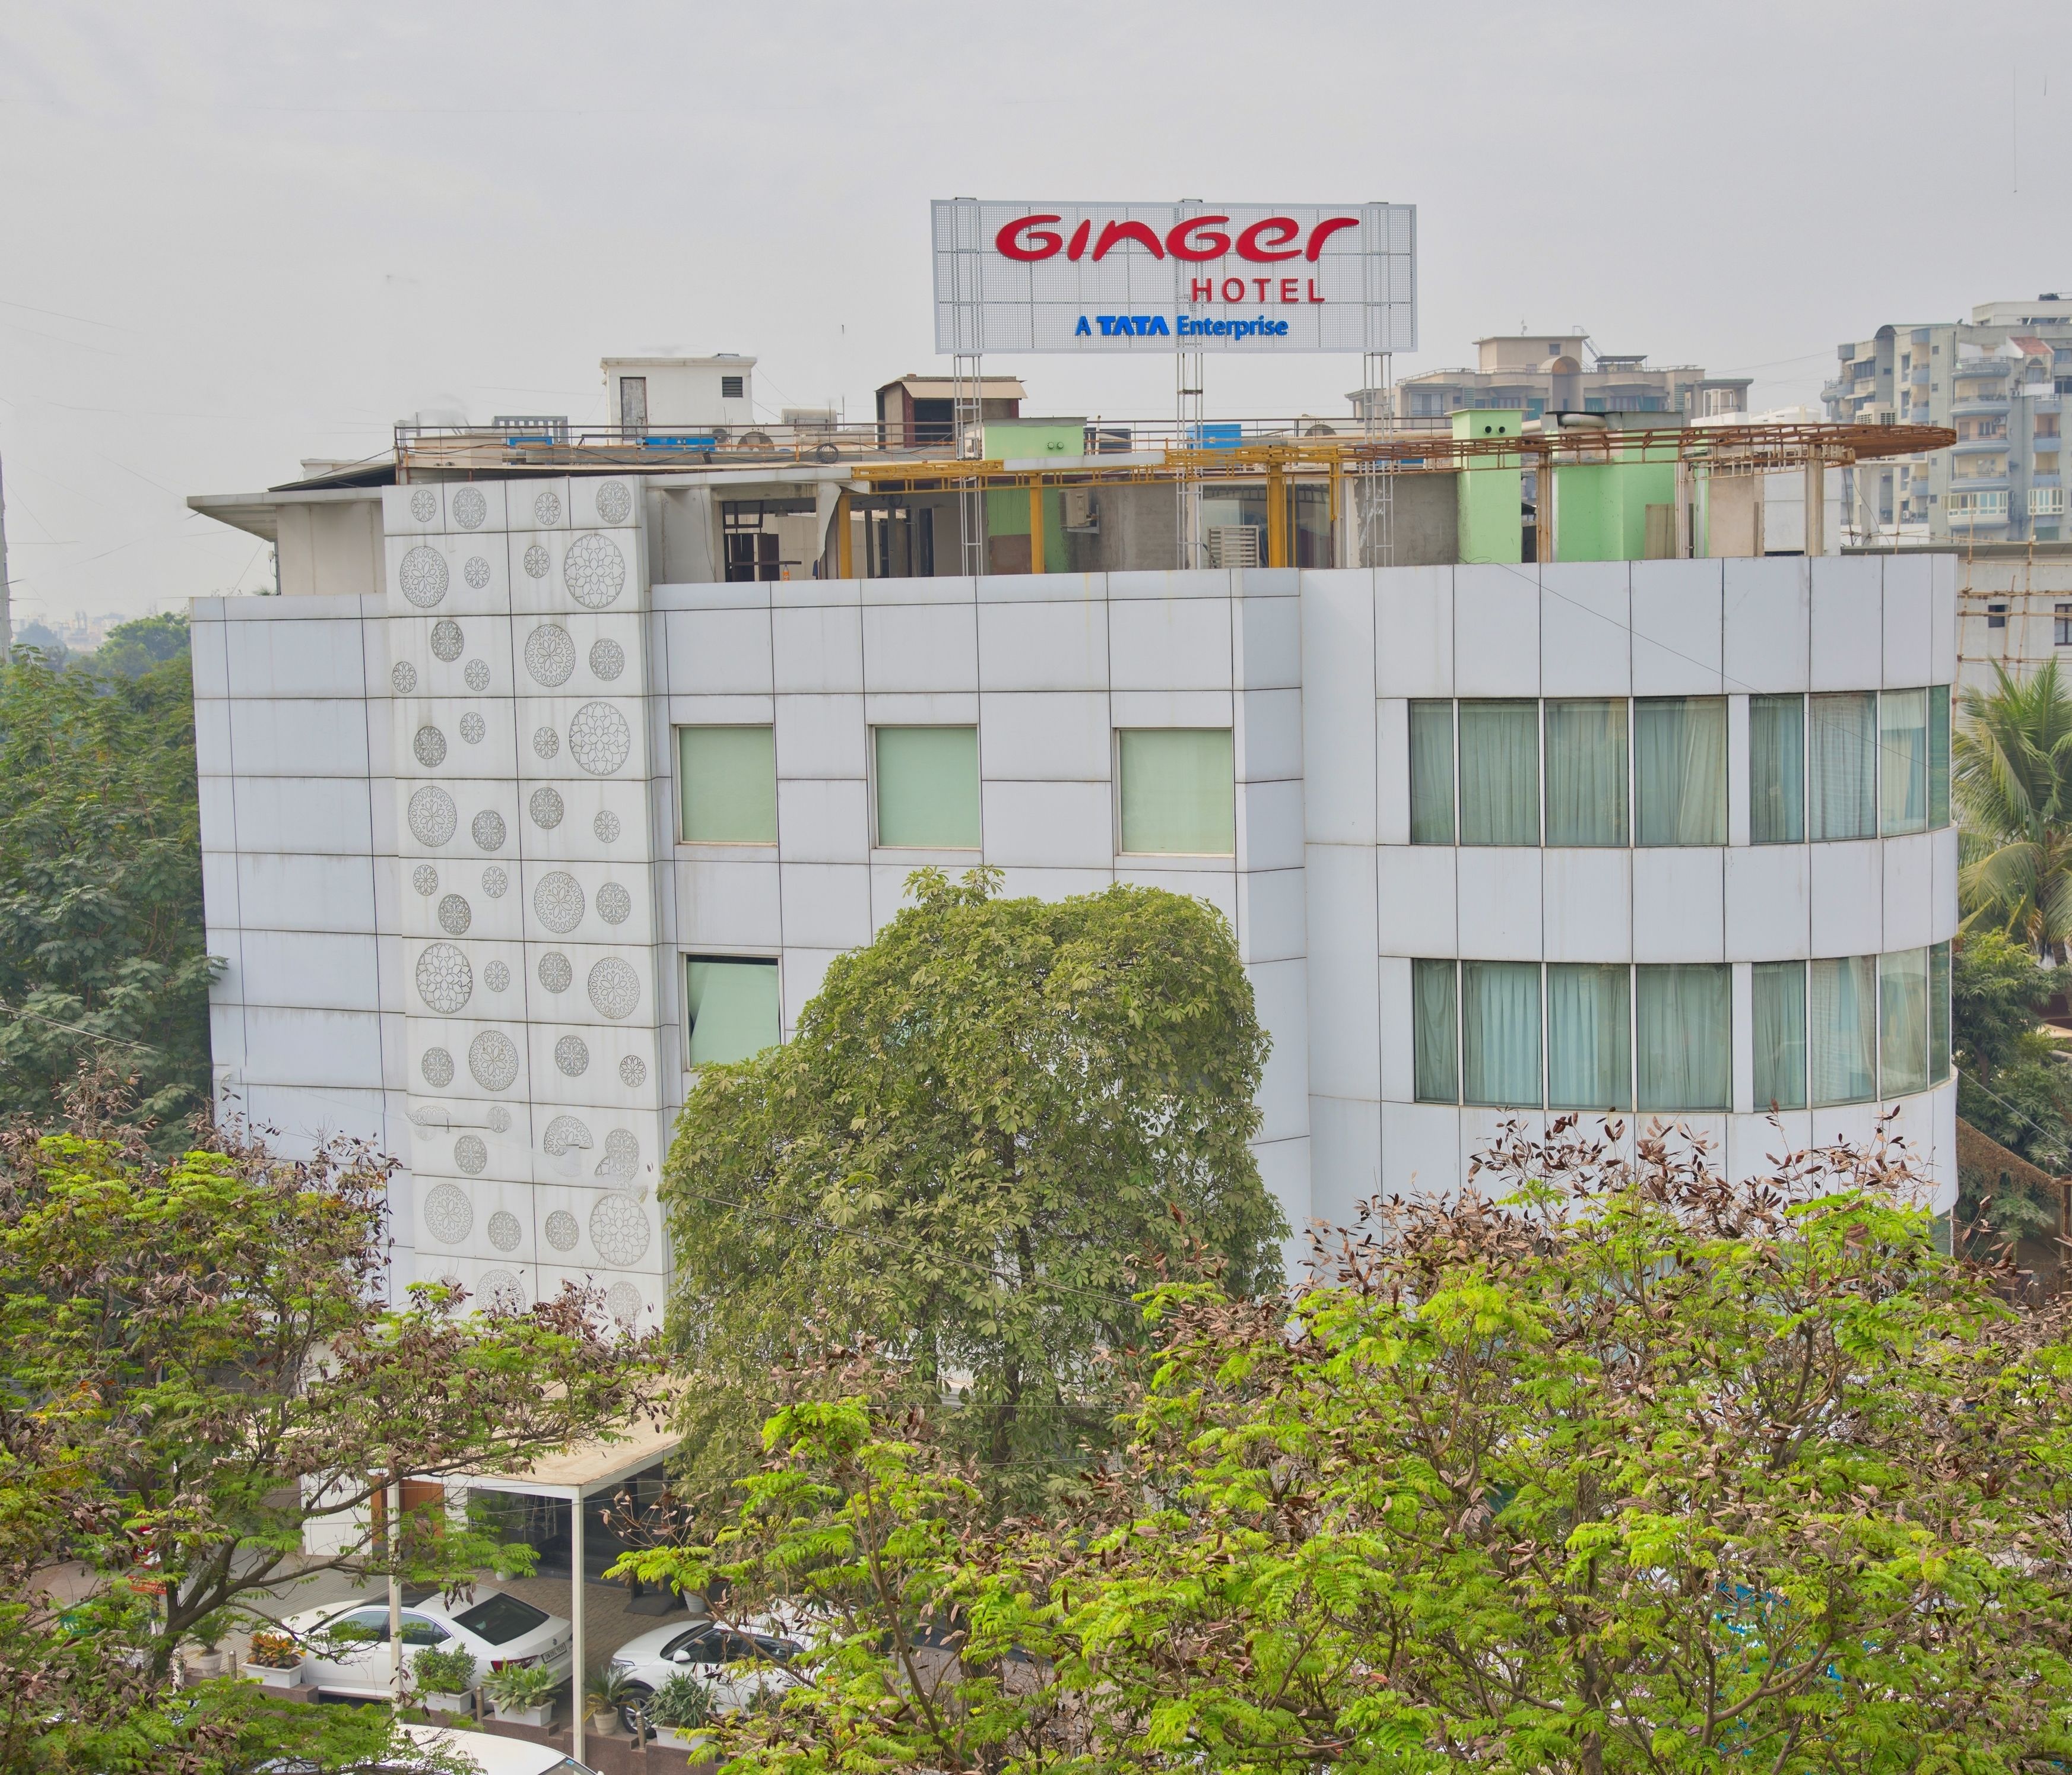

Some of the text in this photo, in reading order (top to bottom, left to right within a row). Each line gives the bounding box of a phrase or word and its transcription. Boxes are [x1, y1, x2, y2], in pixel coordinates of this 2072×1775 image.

[1191, 277, 1325, 303] HOTEL
[1075, 315, 1289, 341] A TATA Enterprise
